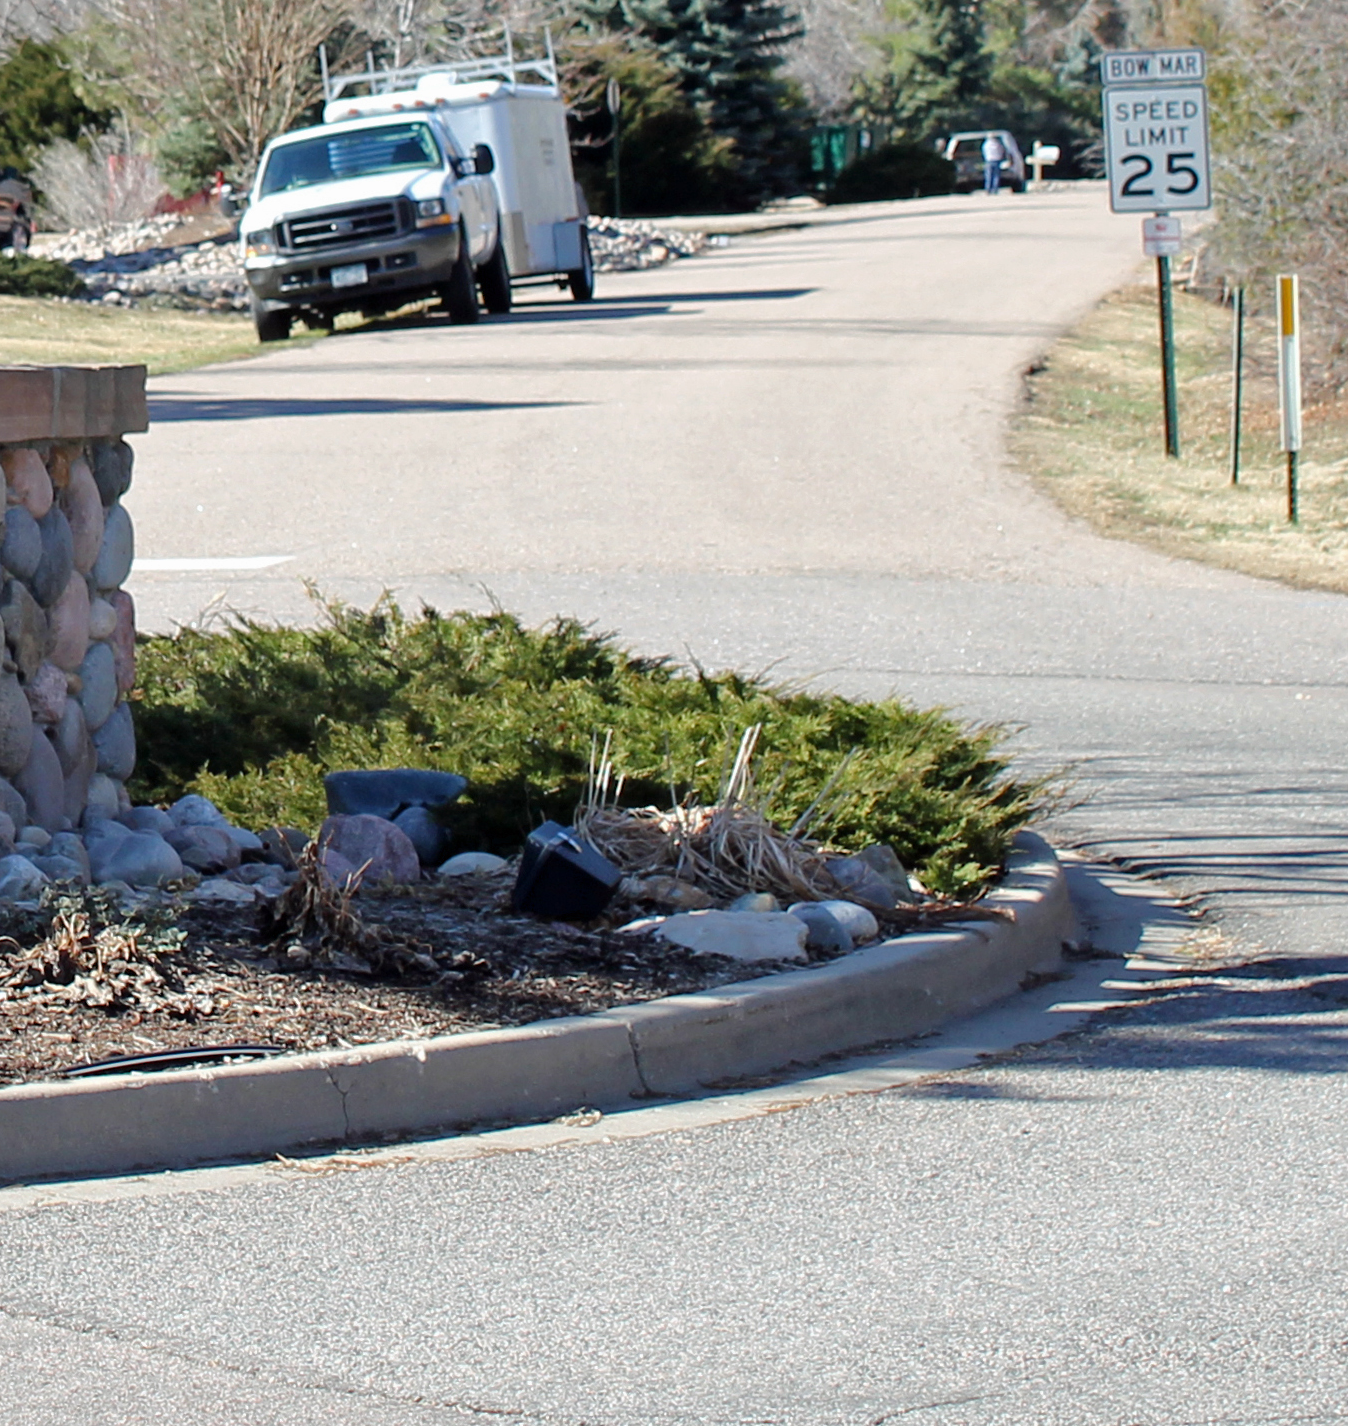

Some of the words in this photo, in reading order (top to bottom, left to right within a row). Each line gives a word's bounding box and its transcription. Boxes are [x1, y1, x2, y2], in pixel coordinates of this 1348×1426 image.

[1111, 58, 1149, 77] BOW
[1160, 55, 1197, 74] MAR
[1115, 101, 1198, 121] SPEED
[1125, 127, 1188, 147] LIMIT
[1120, 152, 1199, 197] 25
